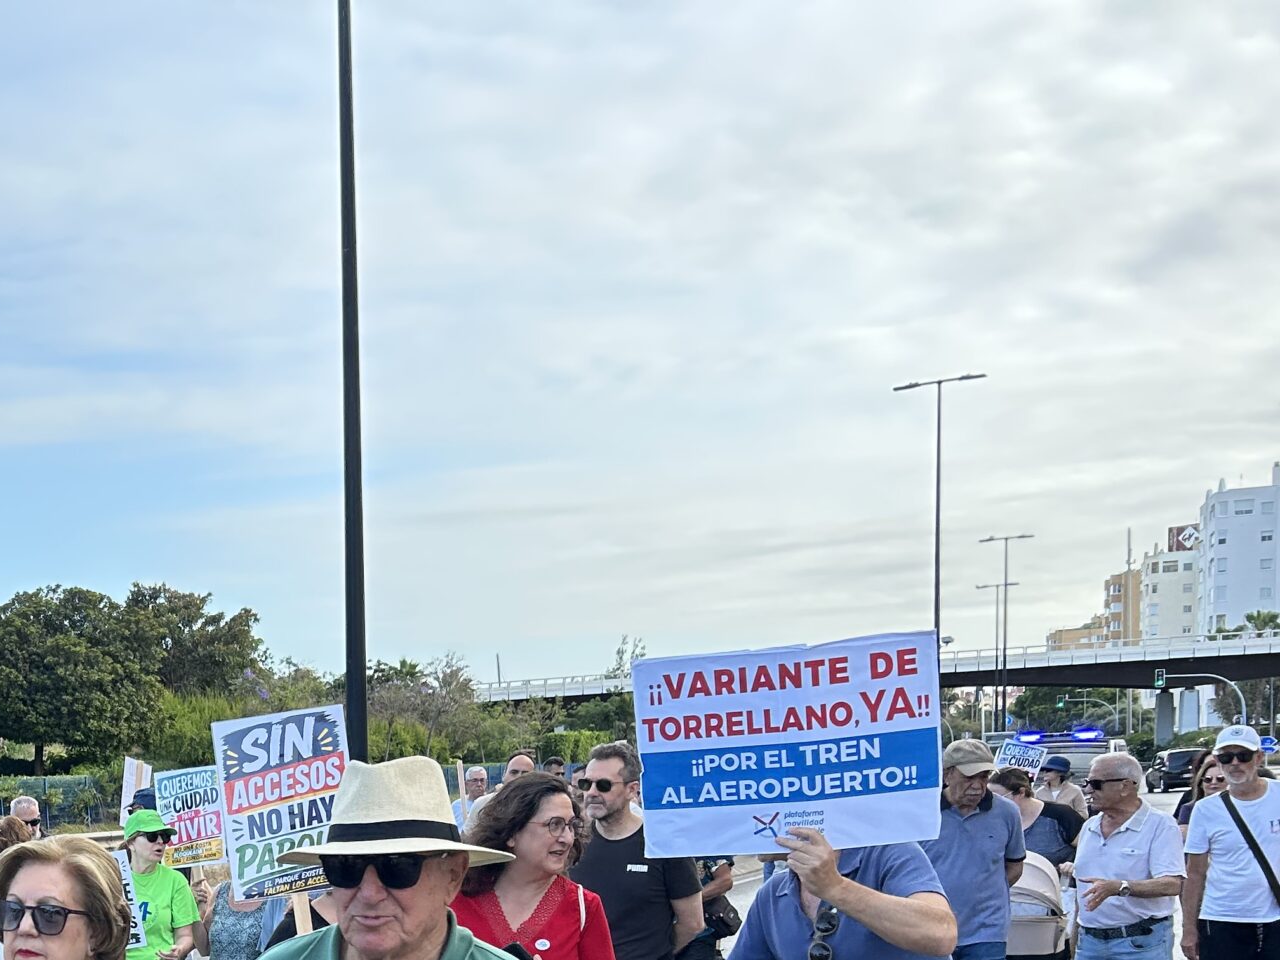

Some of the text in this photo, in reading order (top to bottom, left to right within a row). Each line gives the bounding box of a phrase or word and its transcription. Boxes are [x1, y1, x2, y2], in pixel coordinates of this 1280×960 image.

[648, 647, 918, 706] ¡¡VARIANTE DE
[241, 716, 315, 773] SIN
[691, 737, 881, 777] ¡¡POR EL TREN
[1006, 745, 1041, 759] QUEREMOS
[1009, 756, 1041, 768] CIUDAD
[161, 771, 212, 797] QUEREMOS
[232, 757, 341, 810] ACCESOS
[661, 765, 917, 805] AL AEROPUERTO!!
[173, 787, 218, 813] CIUDAD
[247, 794, 335, 840] NO HAY
[784, 810, 824, 819] plataforma
[785, 818, 824, 827] movilidad
[171, 814, 220, 845] VIVIR
[263, 875, 328, 896] FALTAN LOS ACCE
[275, 875, 299, 885] PARQUE
